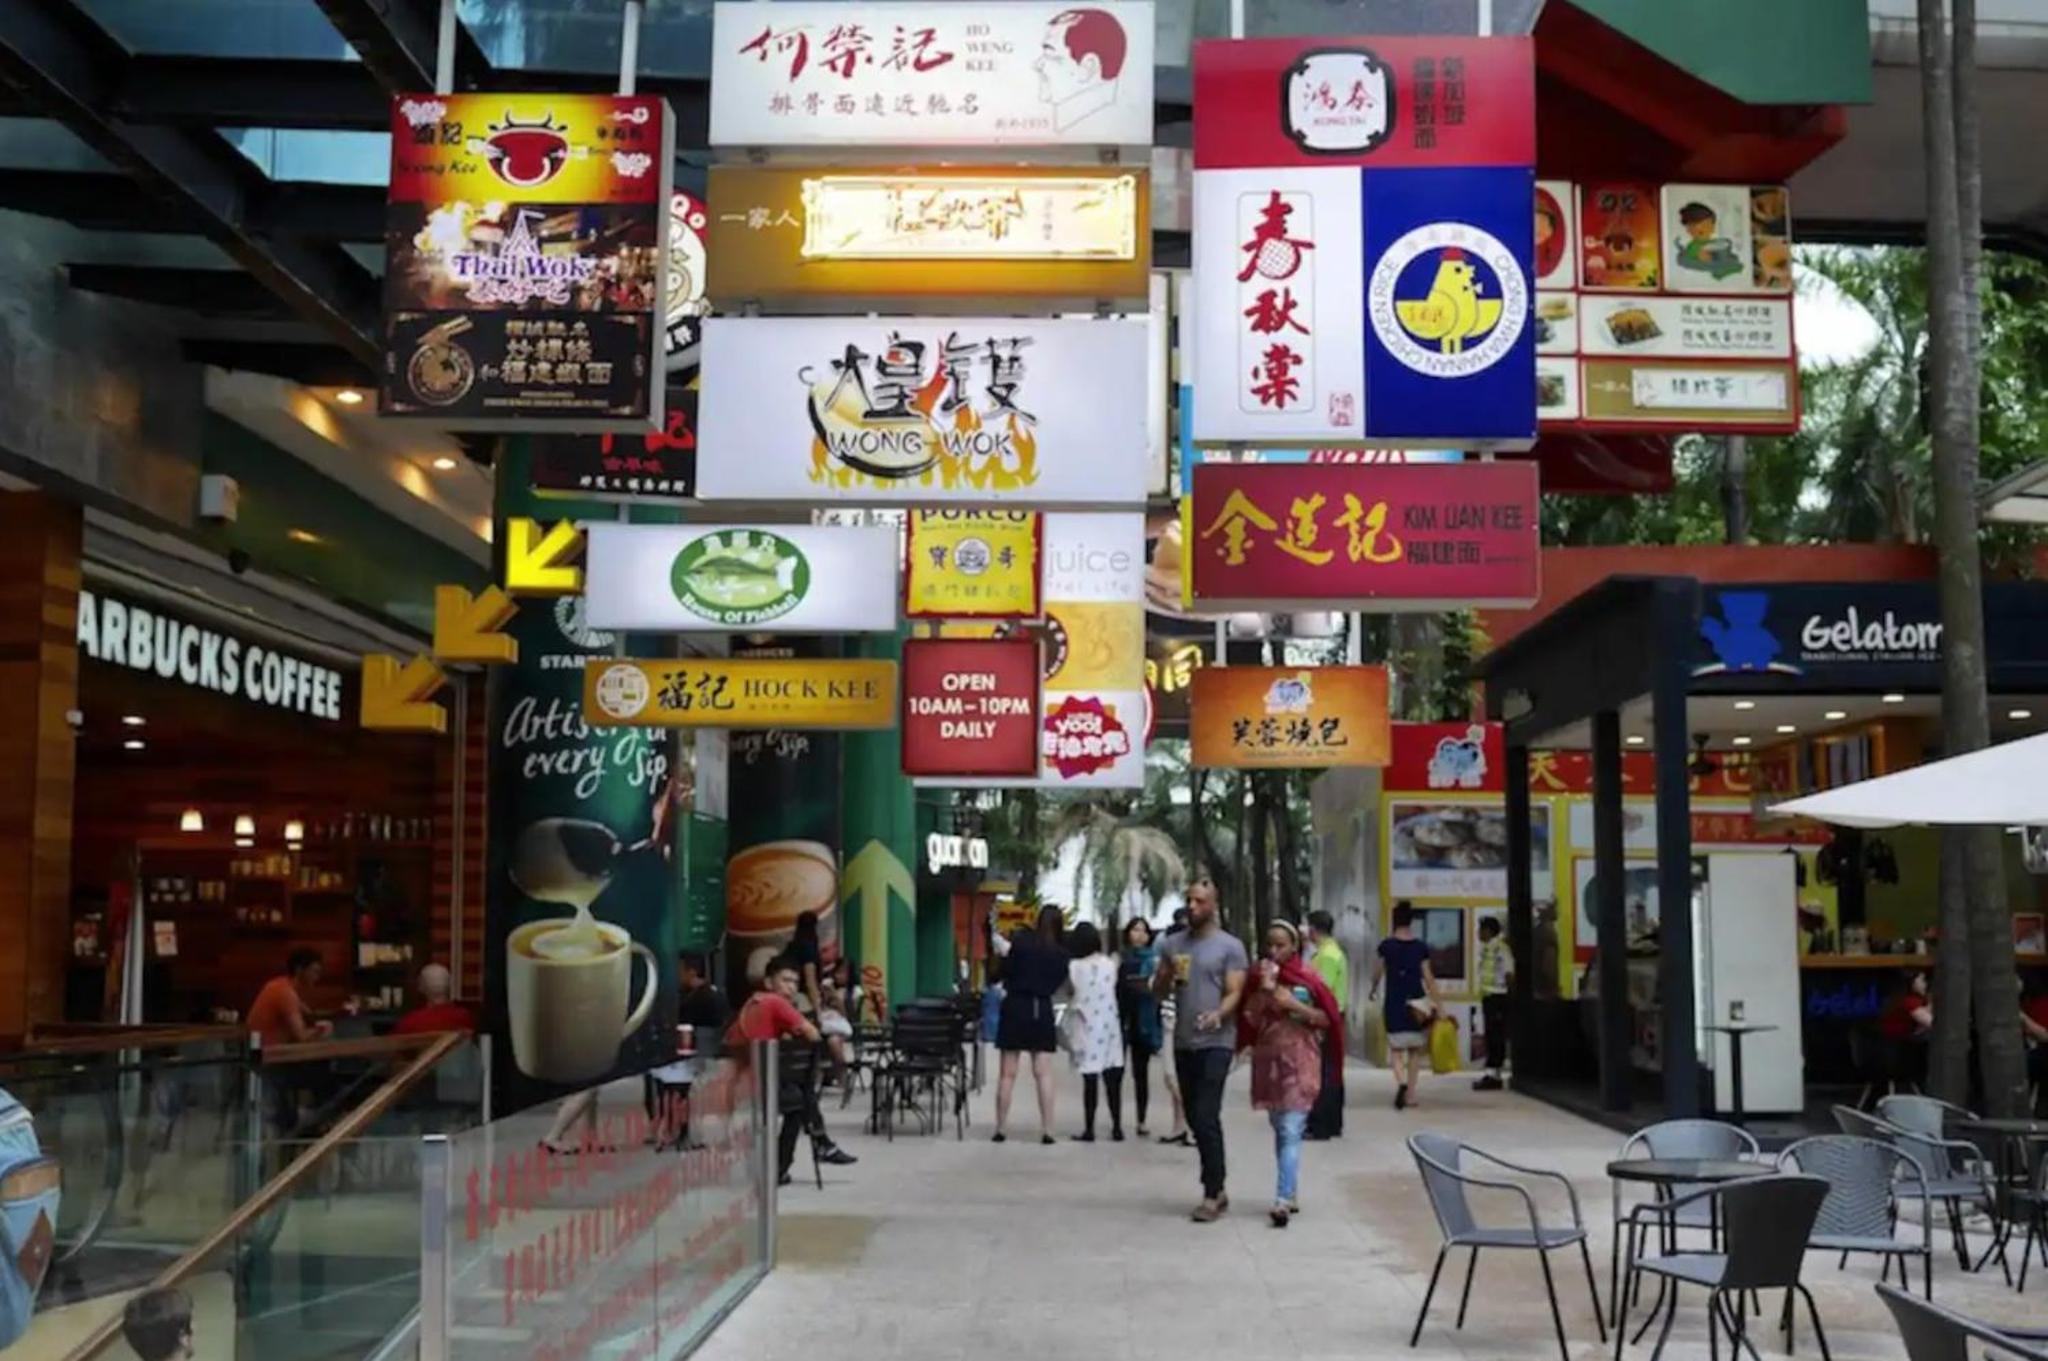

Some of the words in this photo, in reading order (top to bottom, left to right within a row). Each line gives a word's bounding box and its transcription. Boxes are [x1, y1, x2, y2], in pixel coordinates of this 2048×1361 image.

[966, 25, 990, 36] HO
[739, 24, 954, 82] 何榮記
[965, 41, 1013, 54] WENG
[965, 60, 996, 72] KEE
[720, 207, 800, 229] 一家人
[452, 254, 518, 278] Thai
[525, 254, 588, 278] Wok
[829, 431, 923, 454] WONG
[943, 431, 1013, 456] WOK
[1404, 505, 1436, 530] KIM
[1445, 505, 1485, 530] LIAN
[1490, 505, 1524, 530] KEE
[1047, 543, 1131, 575] juice
[681, 592, 721, 623] House
[725, 609, 743, 623] Of
[745, 592, 800, 624] Fishball
[1801, 605, 1943, 651] Gelatom
[78, 590, 239, 696] ARBUCKS
[244, 645, 343, 721] COFFEE
[656, 671, 735, 711] 福記
[743, 678, 818, 699] HOCK
[827, 678, 879, 699] KEE
[942, 673, 995, 691] OPEN
[940, 721, 996, 738] DAILY
[523, 745, 607, 799] every
